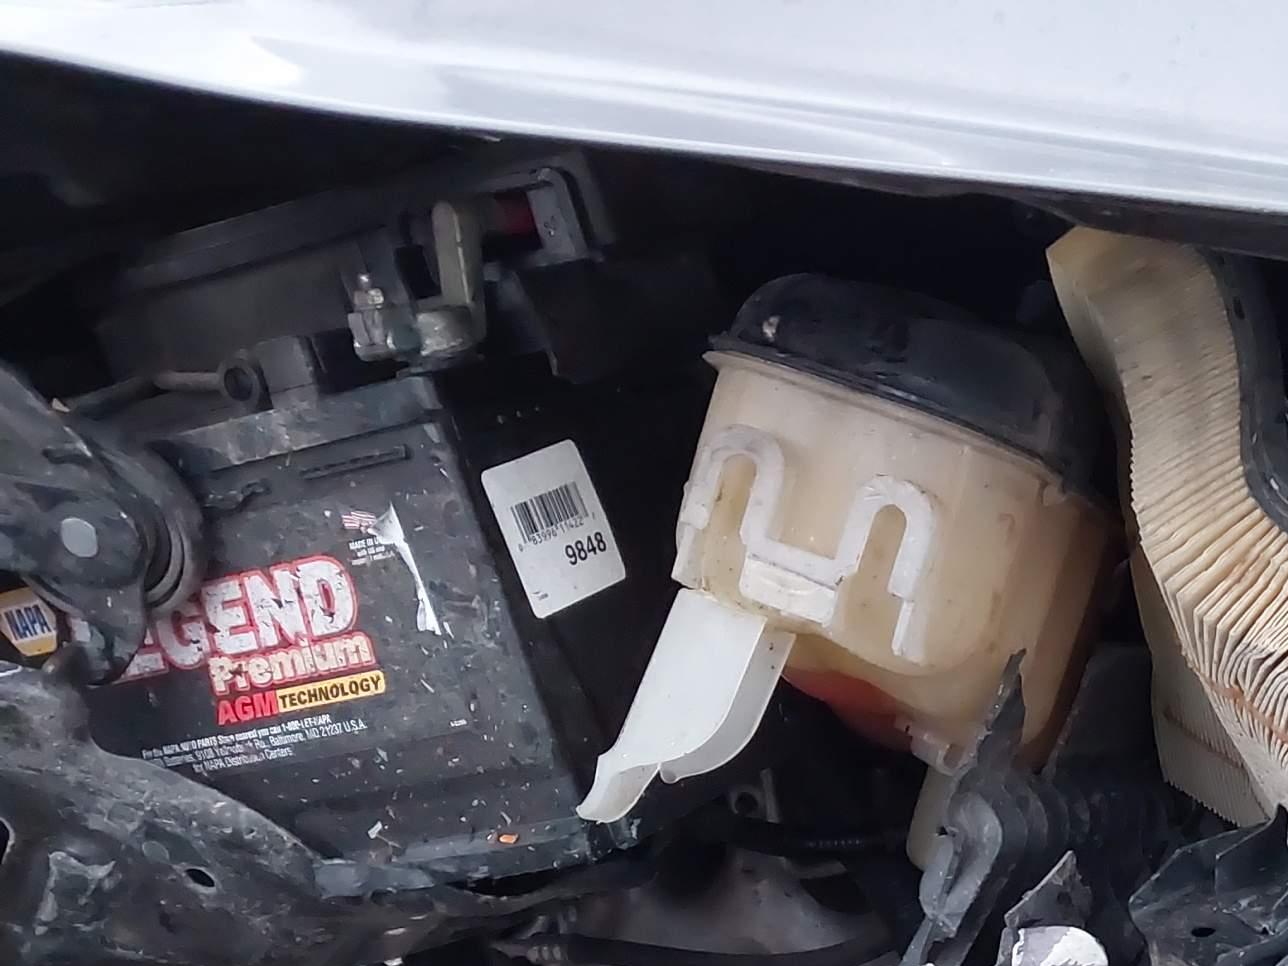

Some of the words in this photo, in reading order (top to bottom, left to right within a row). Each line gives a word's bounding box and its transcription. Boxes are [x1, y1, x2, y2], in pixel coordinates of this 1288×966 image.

[564, 532, 607, 566] 9848
[4, 604, 51, 641] NAPA
[120, 558, 355, 677] GEND
[207, 634, 373, 694] Premium
[217, 691, 279, 726] AGM
[279, 675, 382, 709] TECHNOLOGY
[197, 736, 217, 749] PARTS
[320, 723, 342, 738] 21237
[343, 719, 368, 732] U.S.A.
